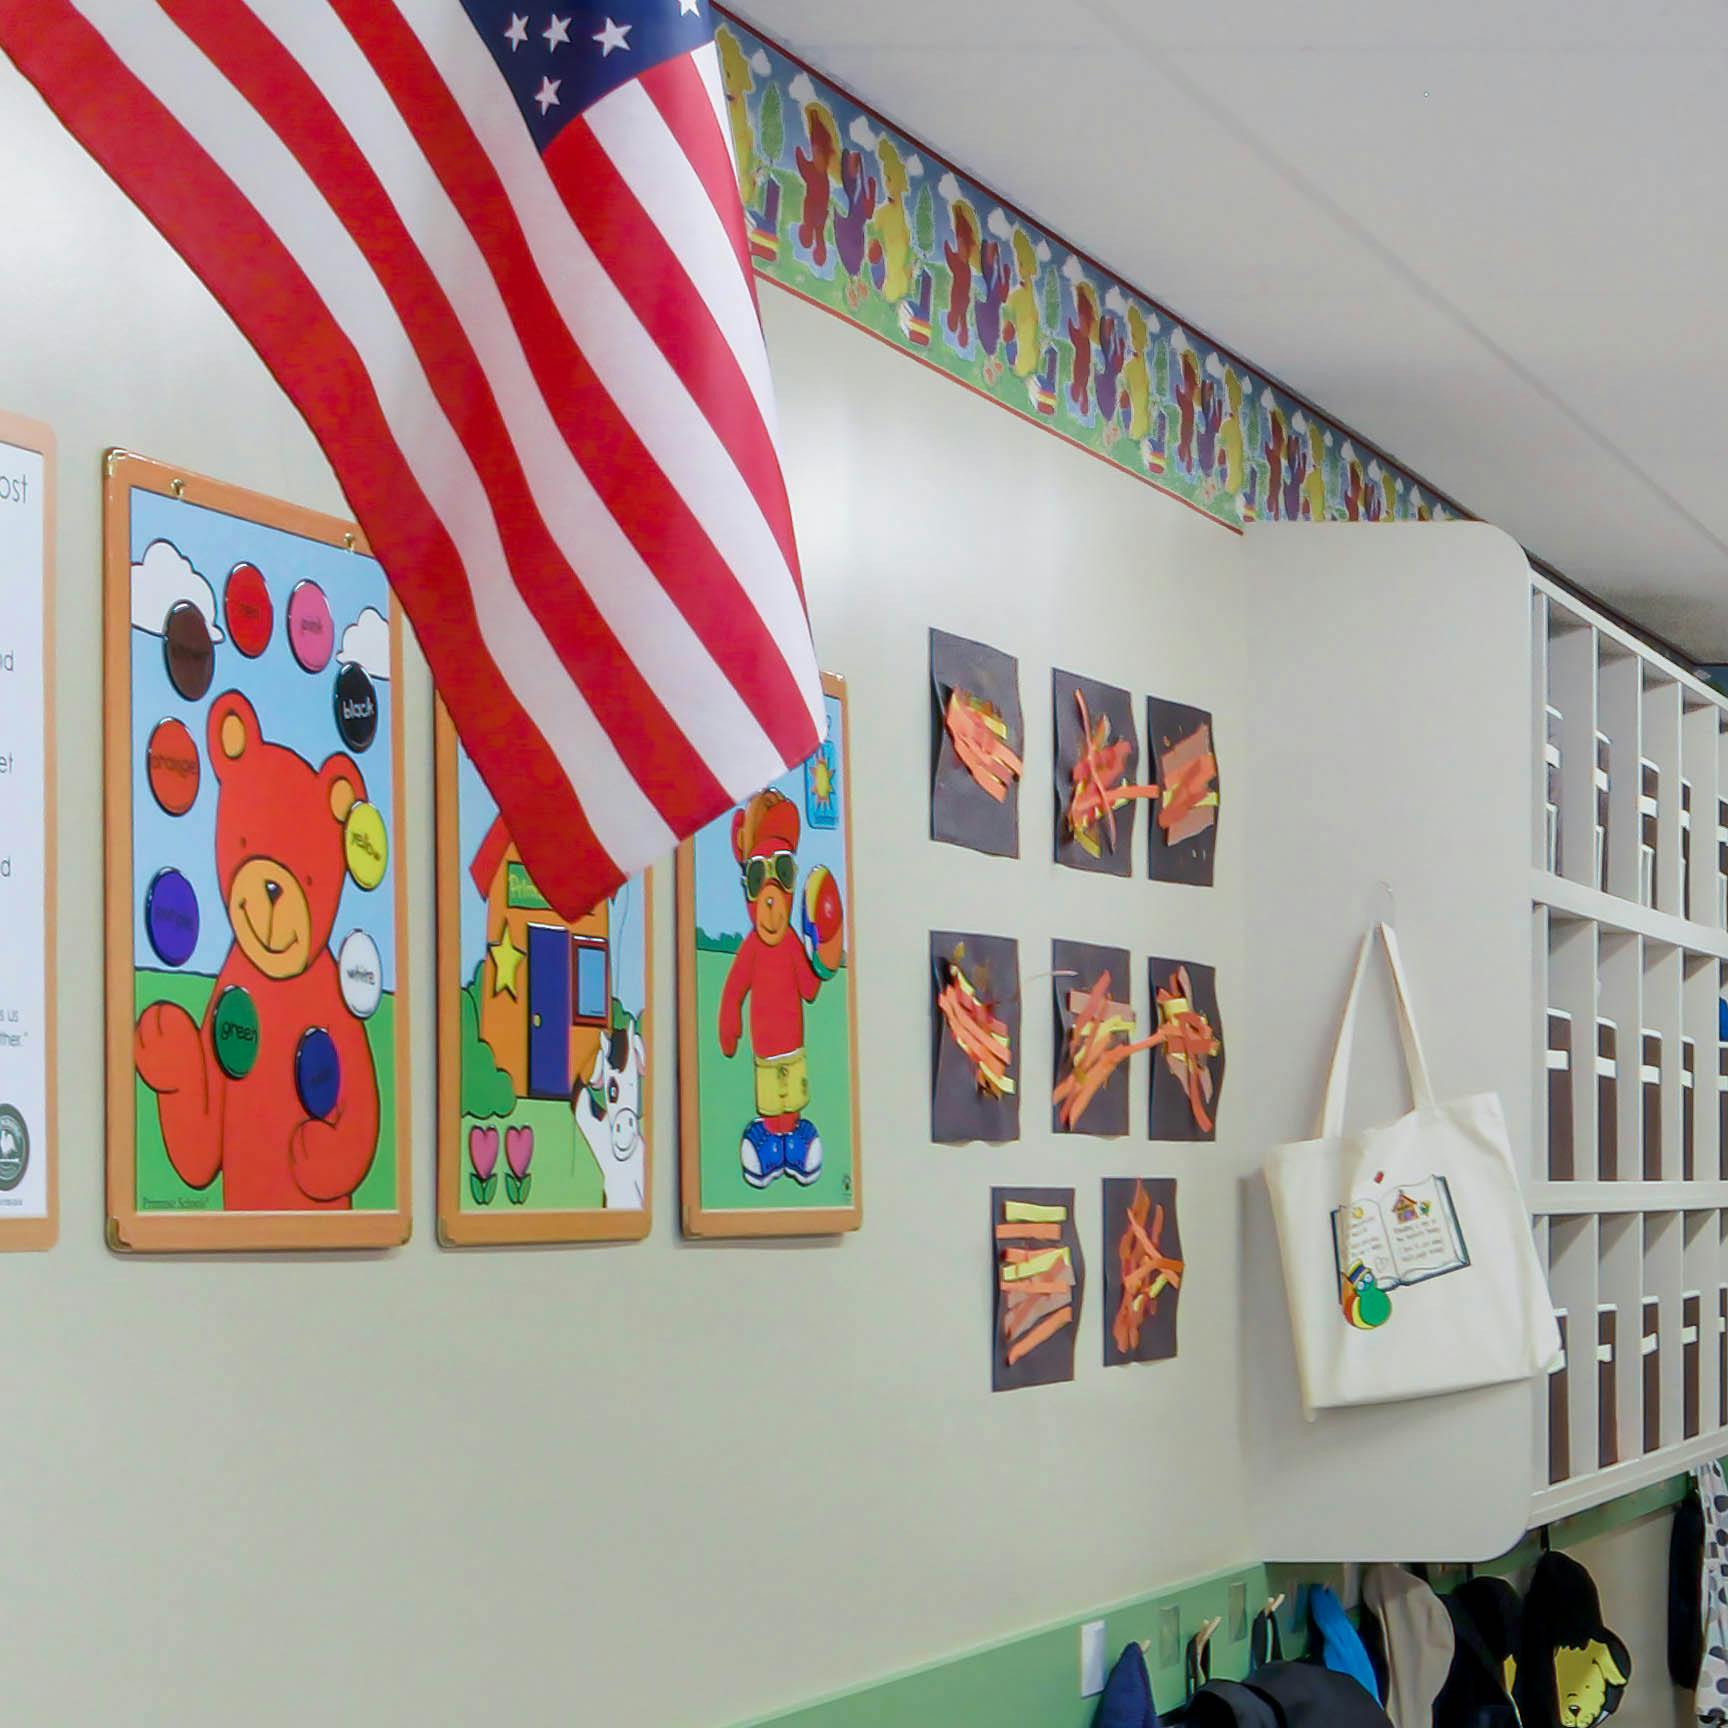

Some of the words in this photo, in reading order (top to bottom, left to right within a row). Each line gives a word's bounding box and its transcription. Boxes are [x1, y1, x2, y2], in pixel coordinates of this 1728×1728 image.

[342, 698, 375, 720] black
[346, 965, 377, 986] white
[220, 1020, 258, 1043] green
